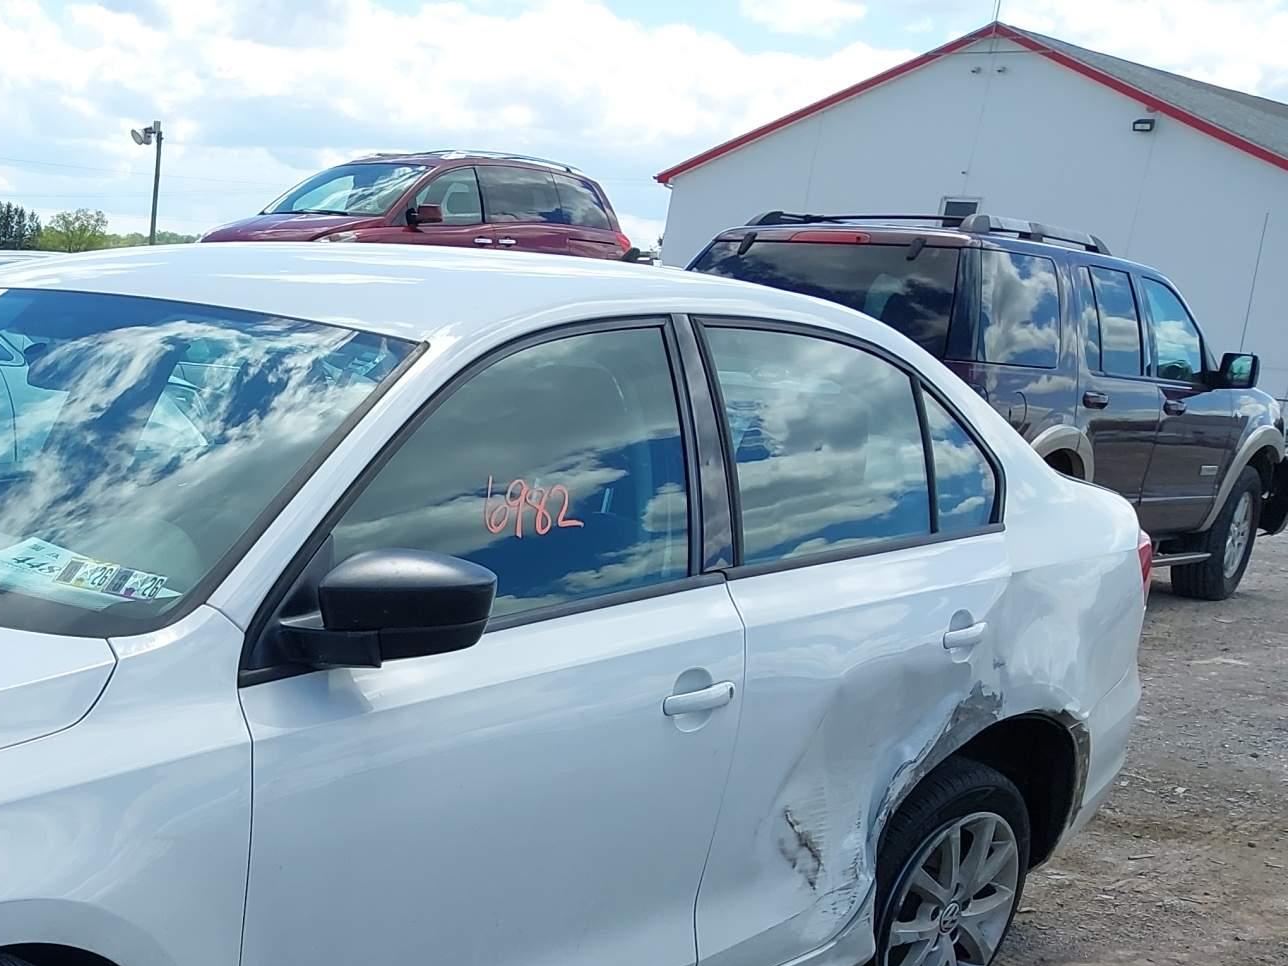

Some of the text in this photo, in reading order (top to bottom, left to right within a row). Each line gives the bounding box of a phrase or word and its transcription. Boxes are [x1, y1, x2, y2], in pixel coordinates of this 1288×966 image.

[484, 474, 584, 539] 6982
[90, 566, 114, 586] 26
[141, 576, 165, 598] 26
